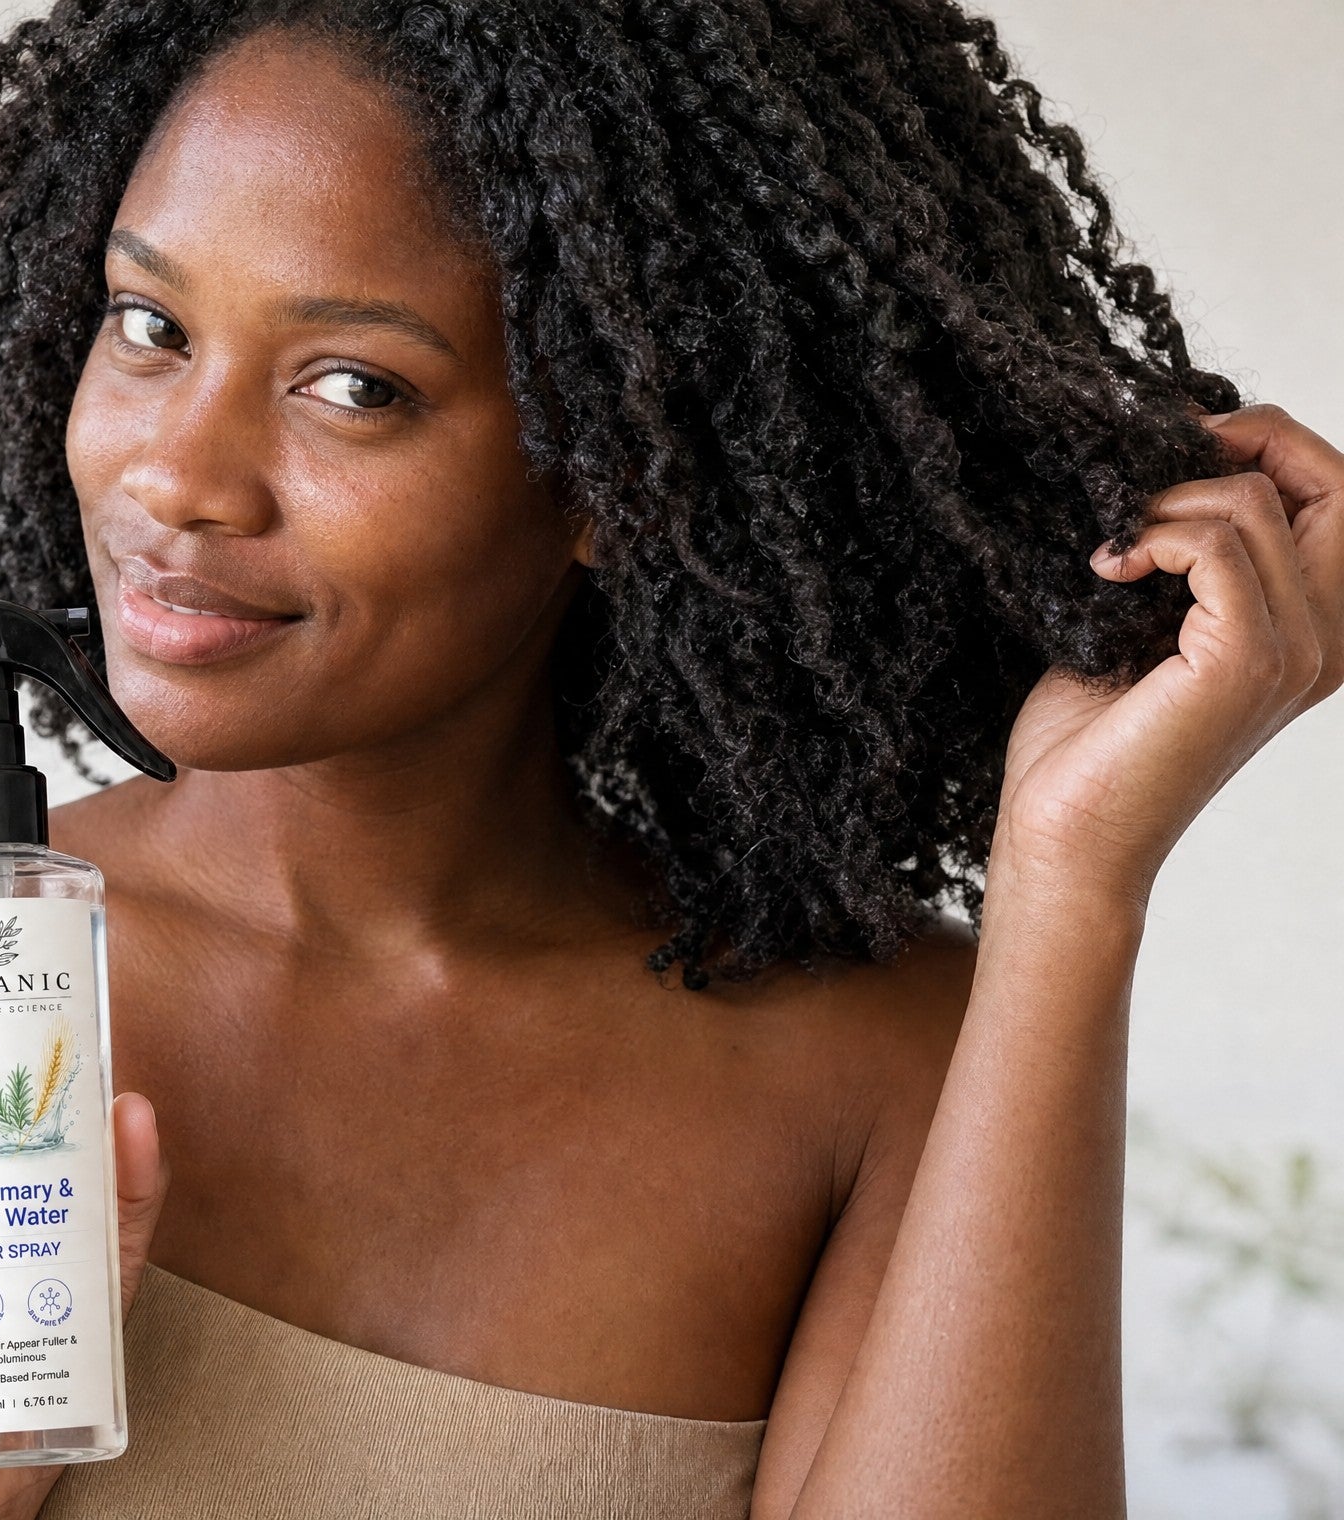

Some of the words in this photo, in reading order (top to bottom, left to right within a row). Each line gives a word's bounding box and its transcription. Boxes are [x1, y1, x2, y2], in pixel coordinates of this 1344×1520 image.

[9, 1003, 63, 1014] SCIENCE
[59, 1178, 74, 1197] &
[5, 1206, 69, 1227] Water
[8, 1241, 61, 1259] SPRAY
[7, 1339, 41, 1351] Appear
[42, 1336, 68, 1347] Fuller
[70, 1335, 78, 1345] &
[31, 1369, 70, 1381] Formula
[23, 1396, 46, 1408] 6.76
[47, 1395, 55, 1406] fl
[56, 1396, 69, 1406] oz
